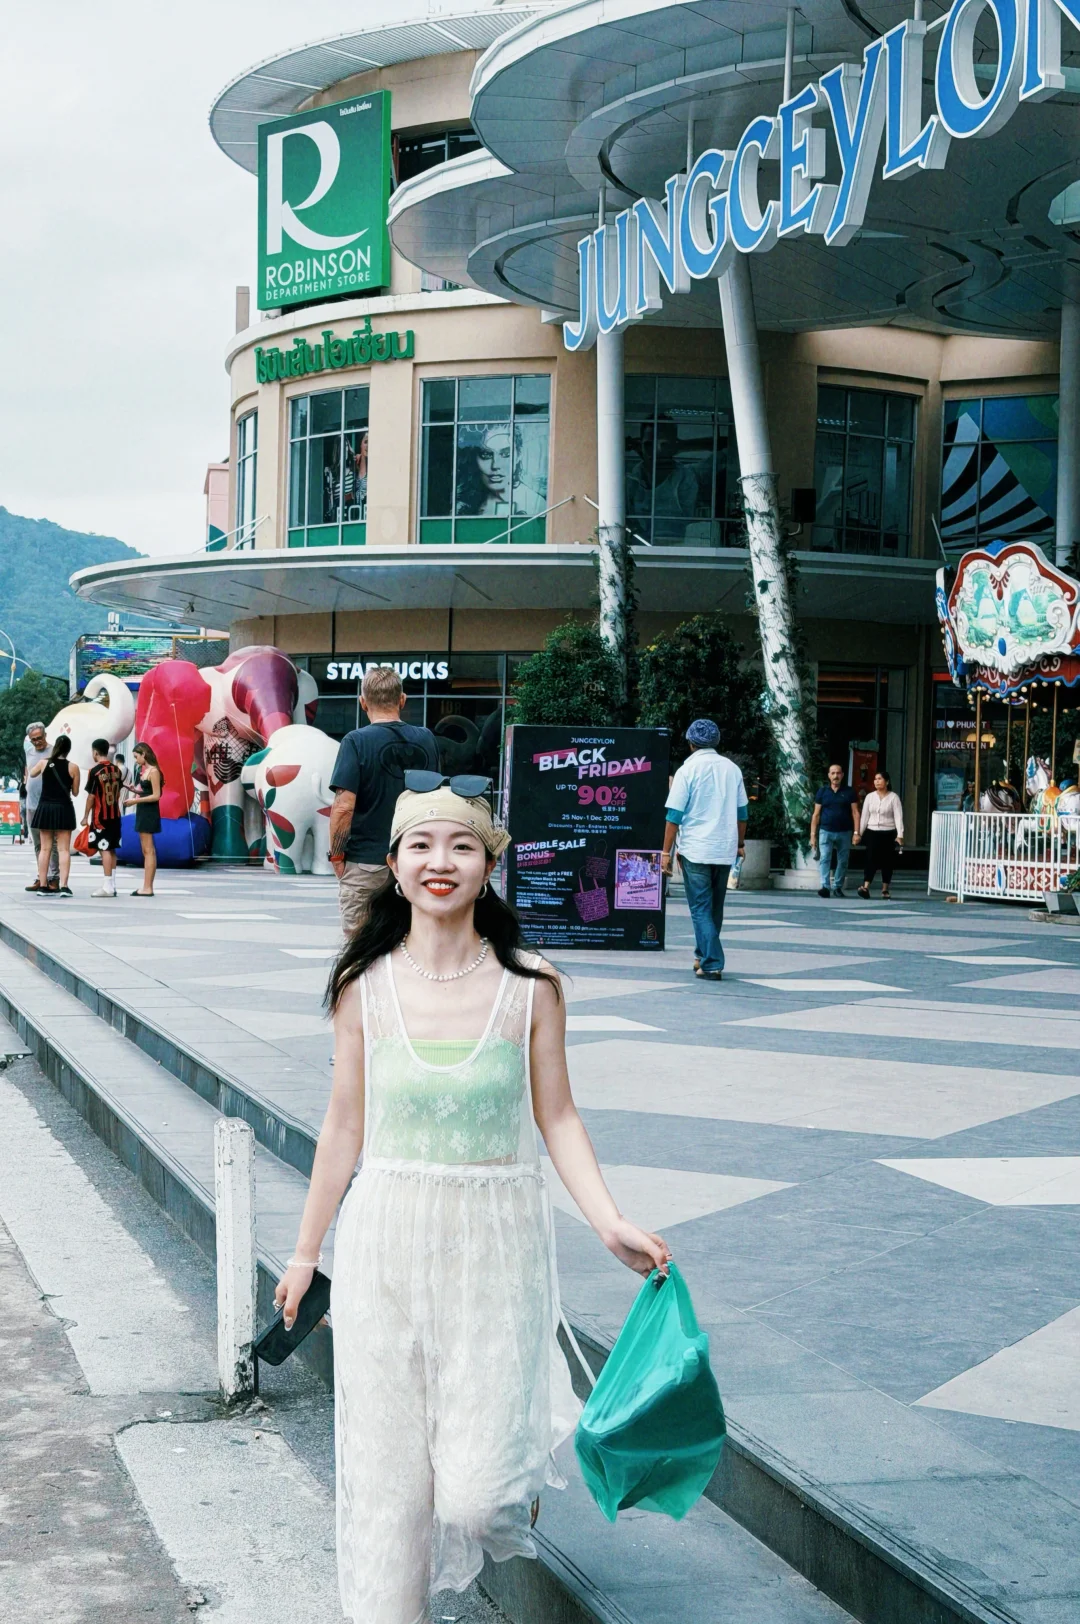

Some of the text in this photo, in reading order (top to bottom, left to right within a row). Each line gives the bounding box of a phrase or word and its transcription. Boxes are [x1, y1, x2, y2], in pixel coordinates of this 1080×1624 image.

[266, 246, 370, 289] ROBINSON
[265, 270, 370, 301] DEPARTMENT STORE
[326, 662, 449, 680] STAUCKS
[956, 720, 987, 728] PHUKT
[571, 737, 615, 745] JUNGCEYLON
[936, 741, 987, 749] JUNGCEYLN
[539, 747, 607, 772] BLACK
[578, 756, 647, 780] FRIDAY
[517, 838, 587, 853] DOUBLE SALE
[516, 850, 550, 861] BONUS
